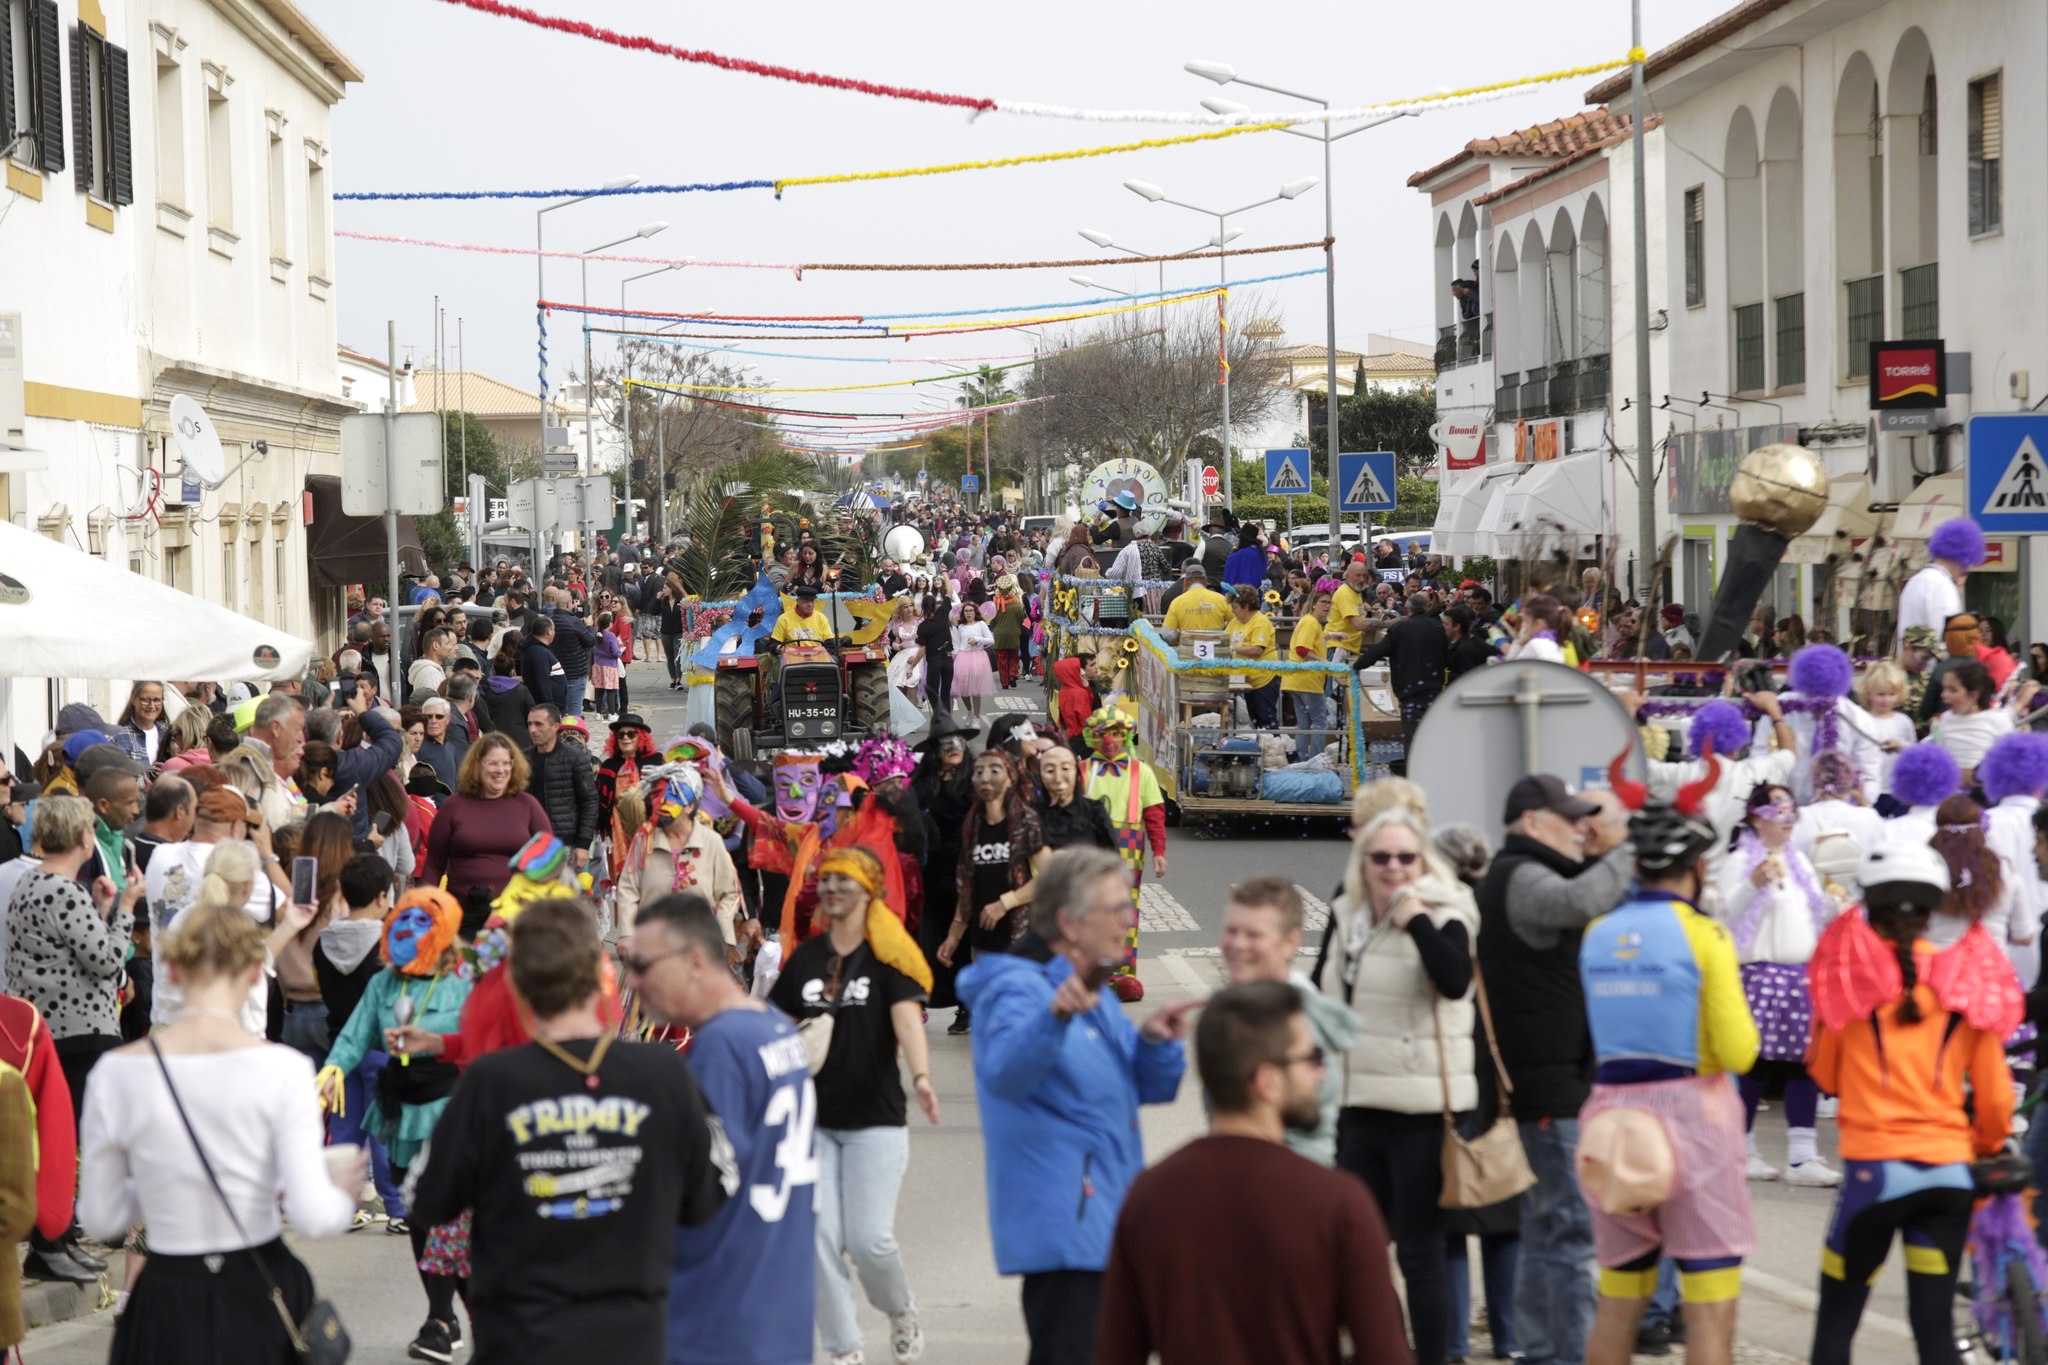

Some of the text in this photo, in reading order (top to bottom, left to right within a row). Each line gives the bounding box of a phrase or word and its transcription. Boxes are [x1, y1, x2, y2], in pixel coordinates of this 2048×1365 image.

[1899, 414, 1929, 425] POTE
[178, 416, 202, 440] NOS
[1448, 425, 1478, 435] Buondi
[1202, 476, 1219, 487] STOP
[1199, 645, 1208, 657] 3
[788, 707, 837, 718] HU-35-02
[506, 1094, 651, 1145] FRIDAY
